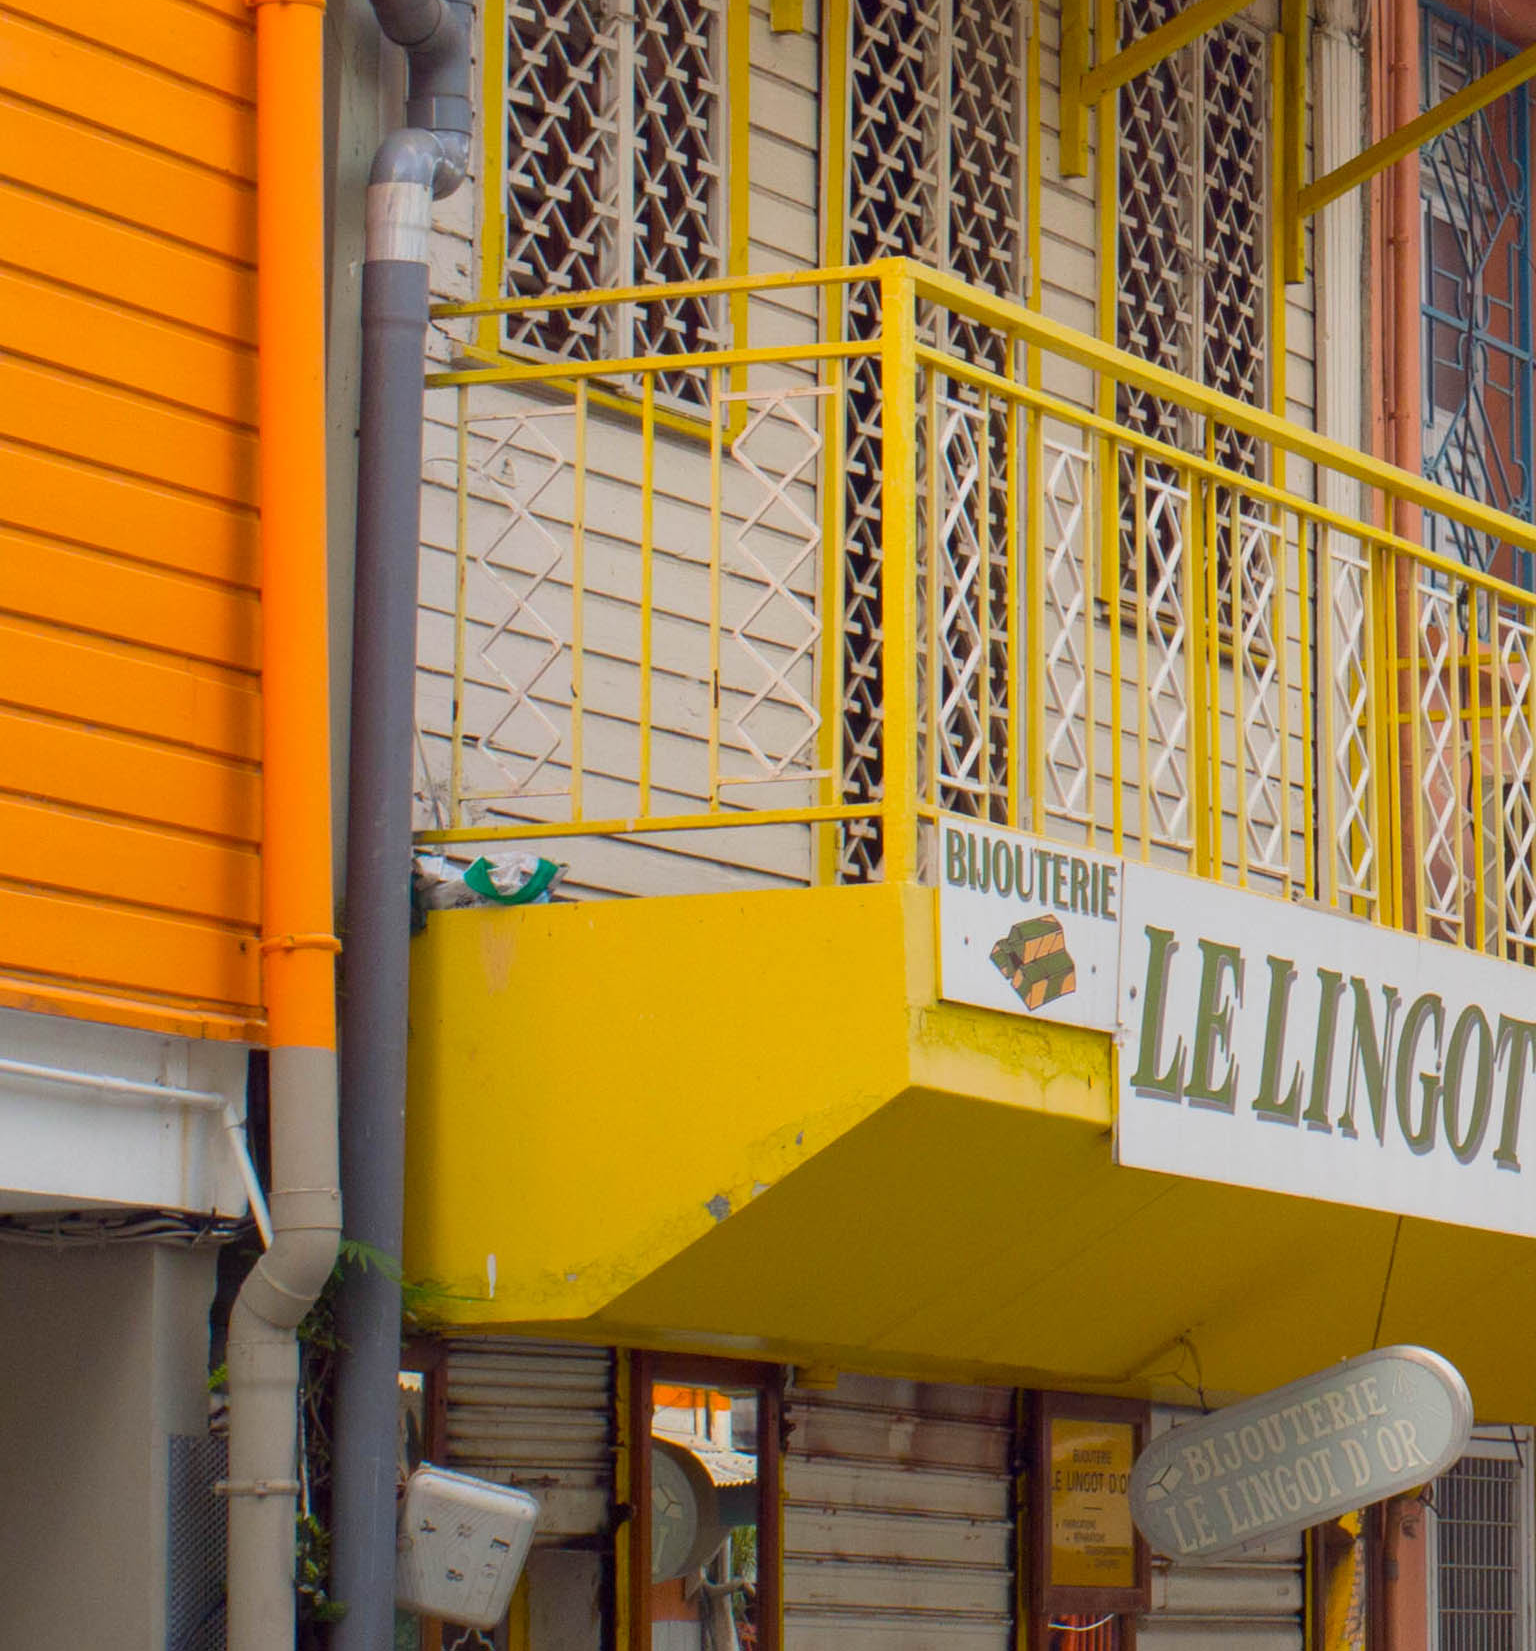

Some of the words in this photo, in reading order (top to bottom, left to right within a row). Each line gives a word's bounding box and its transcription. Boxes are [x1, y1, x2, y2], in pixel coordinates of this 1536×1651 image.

[946, 827, 1118, 922] BIJOUTERIE
[1130, 924, 1246, 1116] LE
[1066, 1470, 1105, 1493] LINGOT
[1109, 1472, 1130, 1495] D'O
[1181, 1376, 1389, 1486] BIJOUTERIE
[1165, 1496, 1218, 1554] LE
[1216, 1447, 1344, 1535] LINGOT
[1341, 1419, 1433, 1488] D'OR
